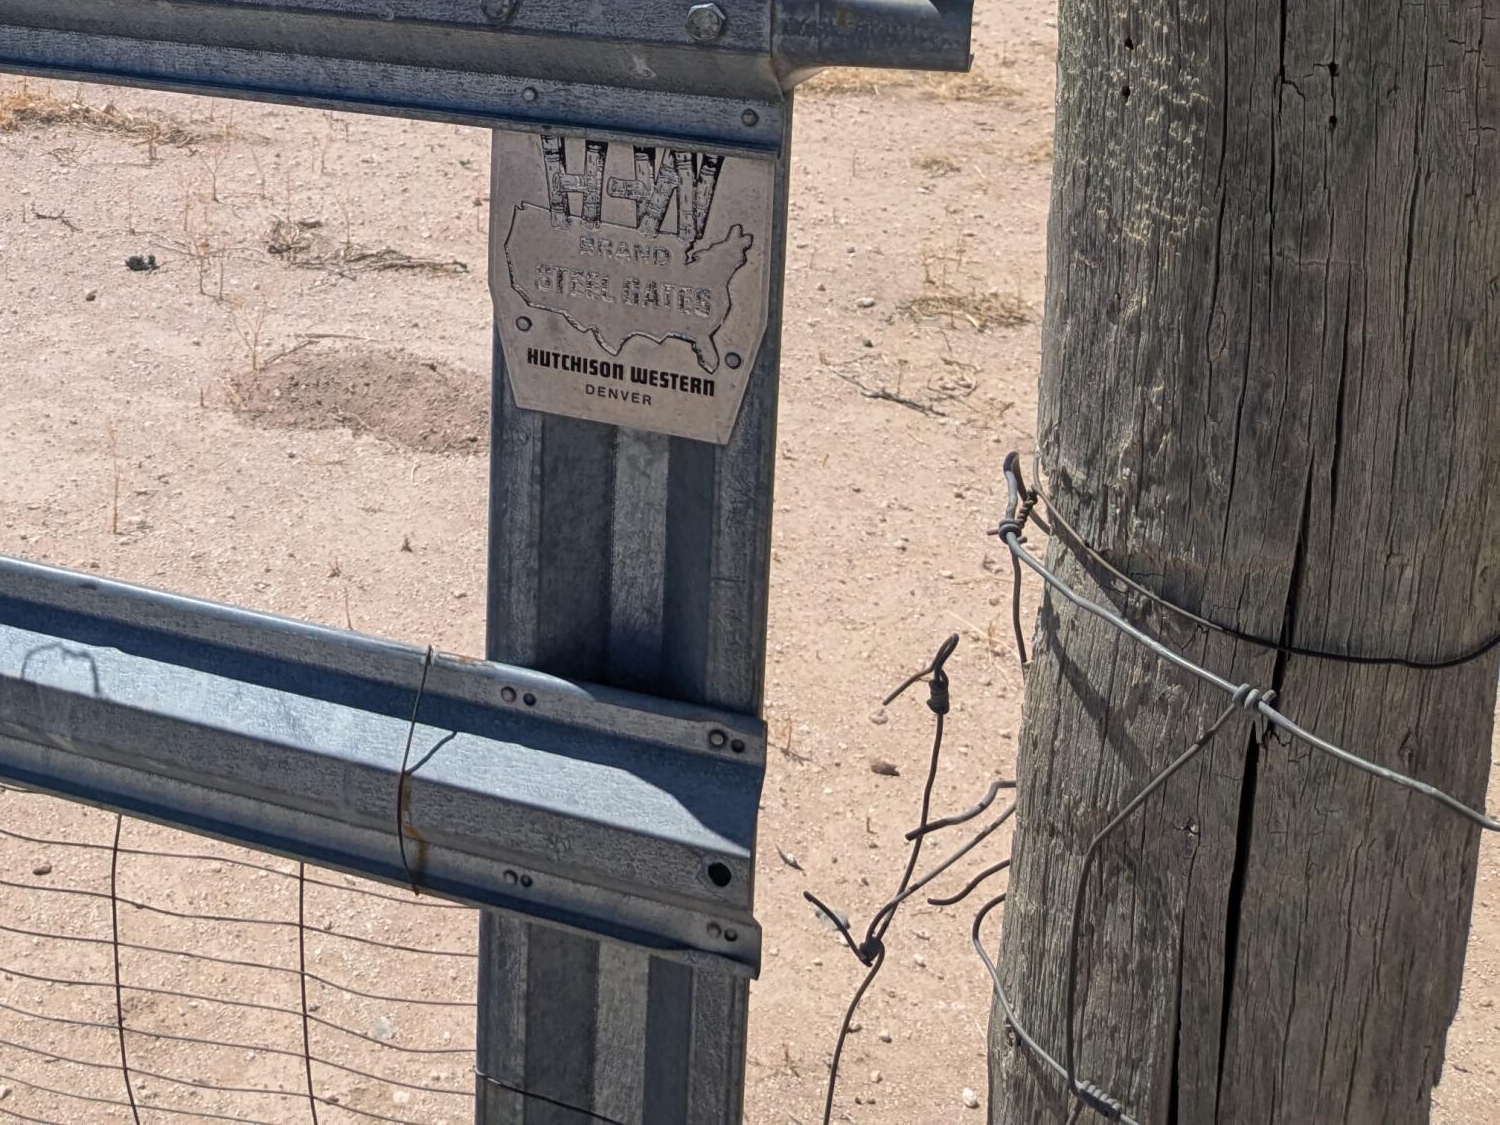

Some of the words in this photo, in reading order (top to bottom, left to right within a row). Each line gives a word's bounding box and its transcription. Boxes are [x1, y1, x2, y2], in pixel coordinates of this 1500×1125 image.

[579, 235, 671, 267] BRAND
[534, 264, 615, 304] STEEL
[622, 276, 714, 318] GATES
[527, 347, 624, 381] HUTCHISON
[630, 365, 715, 397] WESTERN
[585, 384, 652, 406] DENVER
